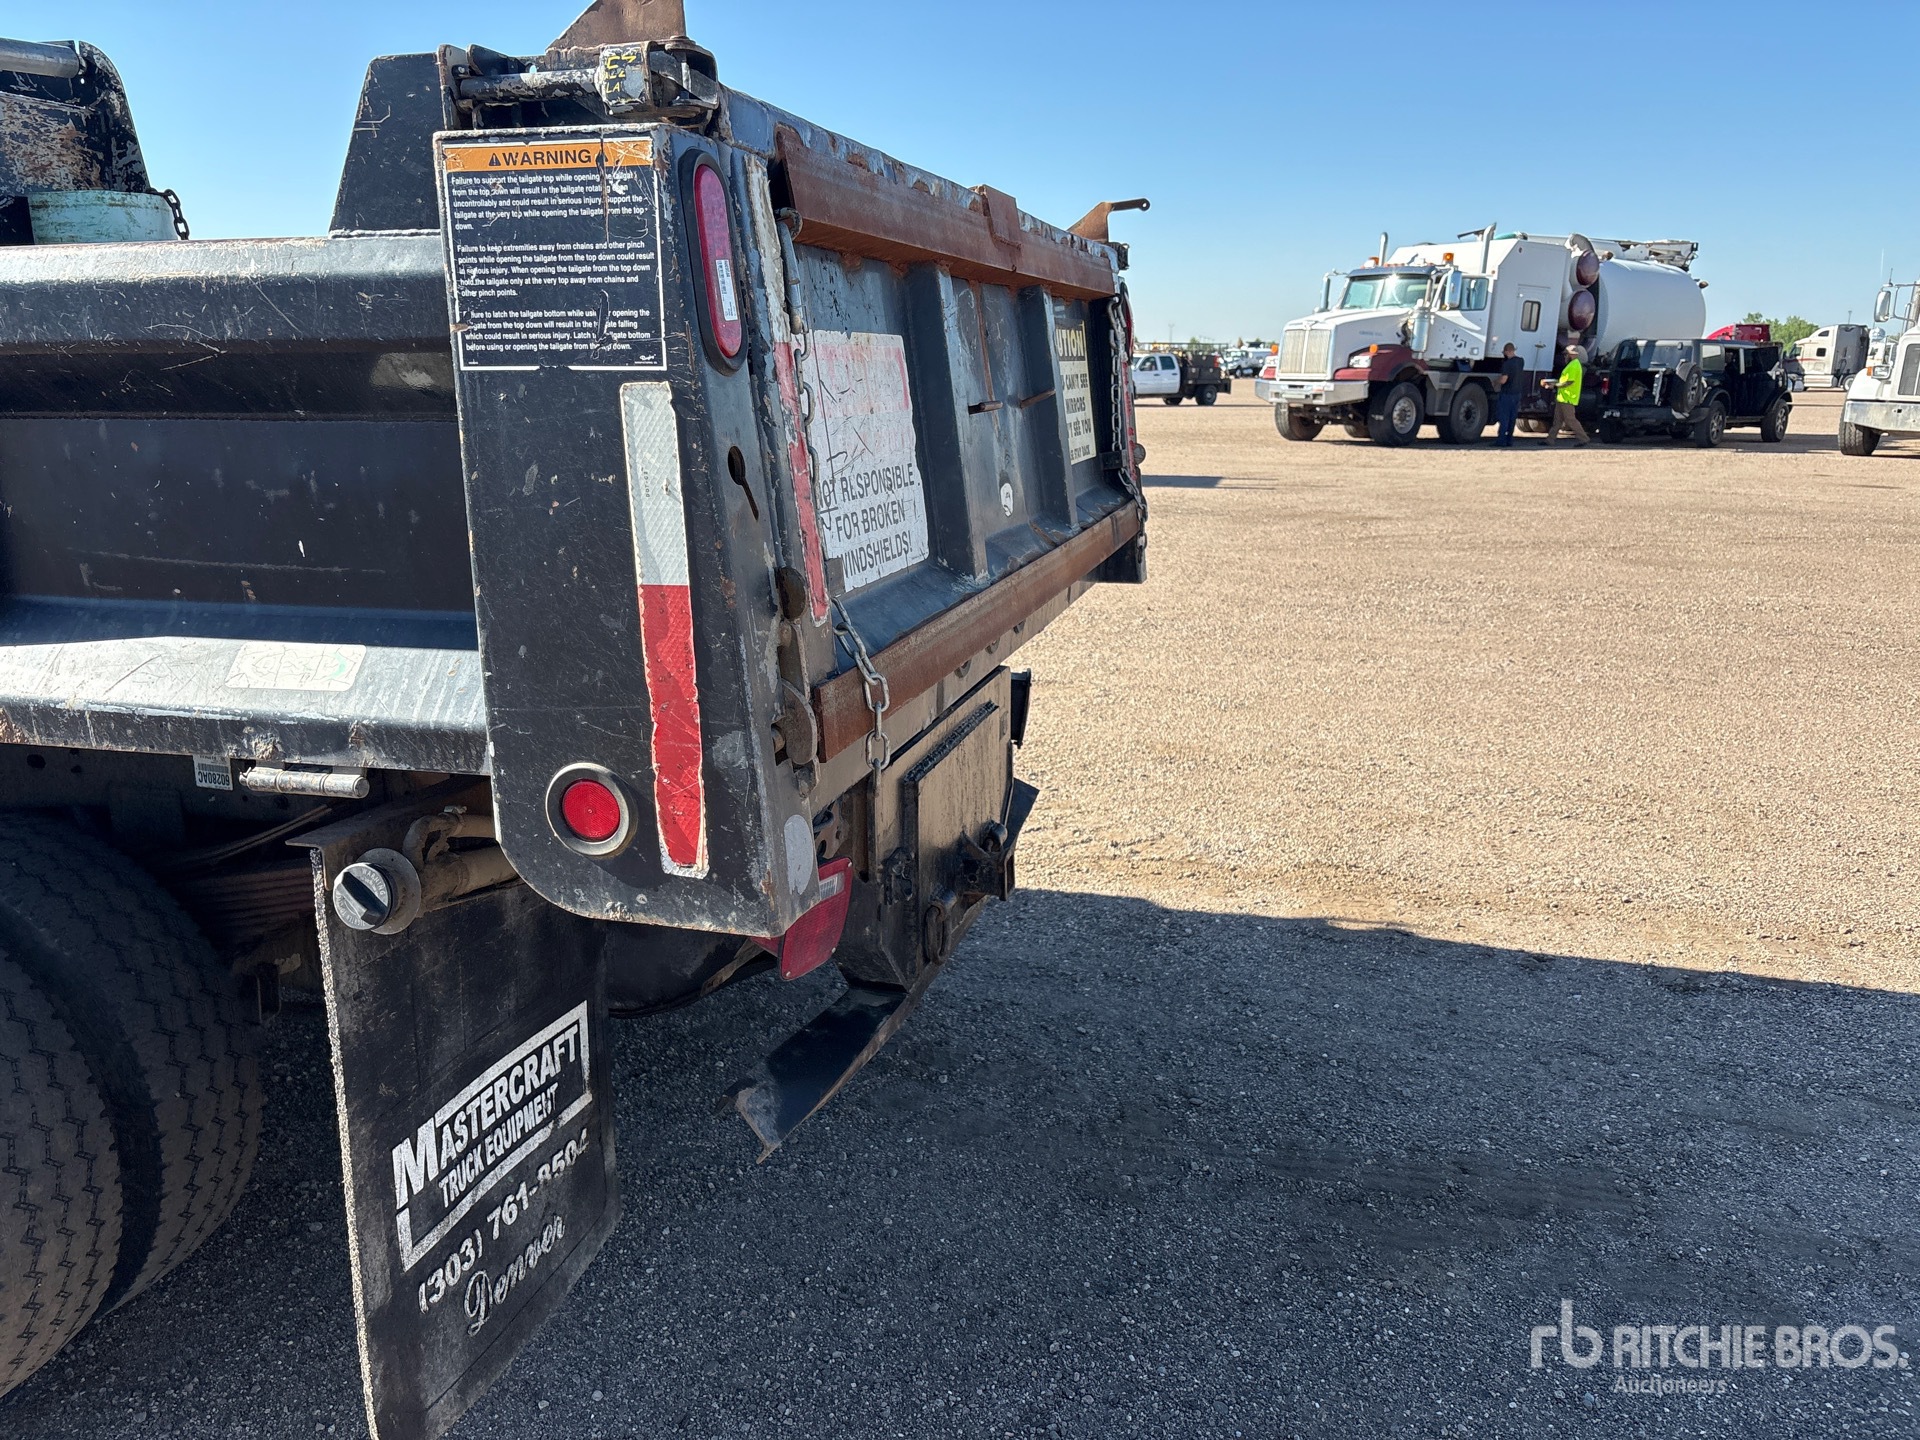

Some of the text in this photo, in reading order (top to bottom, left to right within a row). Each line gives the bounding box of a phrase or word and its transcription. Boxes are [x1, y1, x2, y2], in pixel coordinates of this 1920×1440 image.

[502, 149, 591, 166] WARNING
[519, 175, 542, 183] tailgate
[543, 175, 554, 183] top
[574, 173, 599, 182] opening
[561, 186, 584, 194] tailgate
[453, 199, 497, 208] uncontrollably
[454, 211, 477, 220] tailgate
[497, 211, 510, 219] very
[512, 210, 521, 219] top
[542, 208, 567, 217] opening
[580, 208, 603, 216] tailgate
[633, 207, 644, 215] top
[487, 244, 502, 253] keep
[503, 243, 537, 251] extremities
[627, 241, 644, 250] pinch
[496, 255, 521, 264] opening
[534, 255, 557, 263] tailgate
[586, 254, 596, 262] top
[490, 267, 510, 275] injury.
[530, 266, 555, 275] opening
[568, 265, 591, 274] tailgate
[621, 264, 631, 273] top
[486, 278, 508, 286] tailgate
[510, 278, 523, 286] only
[558, 277, 568, 285] top
[570, 277, 586, 285] away
[479, 289, 495, 297] pinch
[497, 289, 518, 297] points.
[520, 310, 542, 319] tailgate
[612, 309, 638, 318] opening
[488, 321, 502, 329] from
[514, 321, 524, 330] top
[618, 320, 637, 329] falling
[553, 332, 572, 340] injury.
[487, 344, 503, 352] using
[513, 343, 537, 352] opening
[550, 343, 572, 351] tailgate
[1081, 419, 1091, 434] YOU
[836, 499, 905, 542] FOR BROKEN
[198, 771, 230, 786] 60280AC
[362, 868, 386, 896] WARNING
[392, 1024, 578, 1210] MASTERCRAFT
[439, 1082, 558, 1208] TRUCK EQUIPMENT
[418, 1228, 483, 1314] (303)
[464, 1215, 566, 1337] Denver
